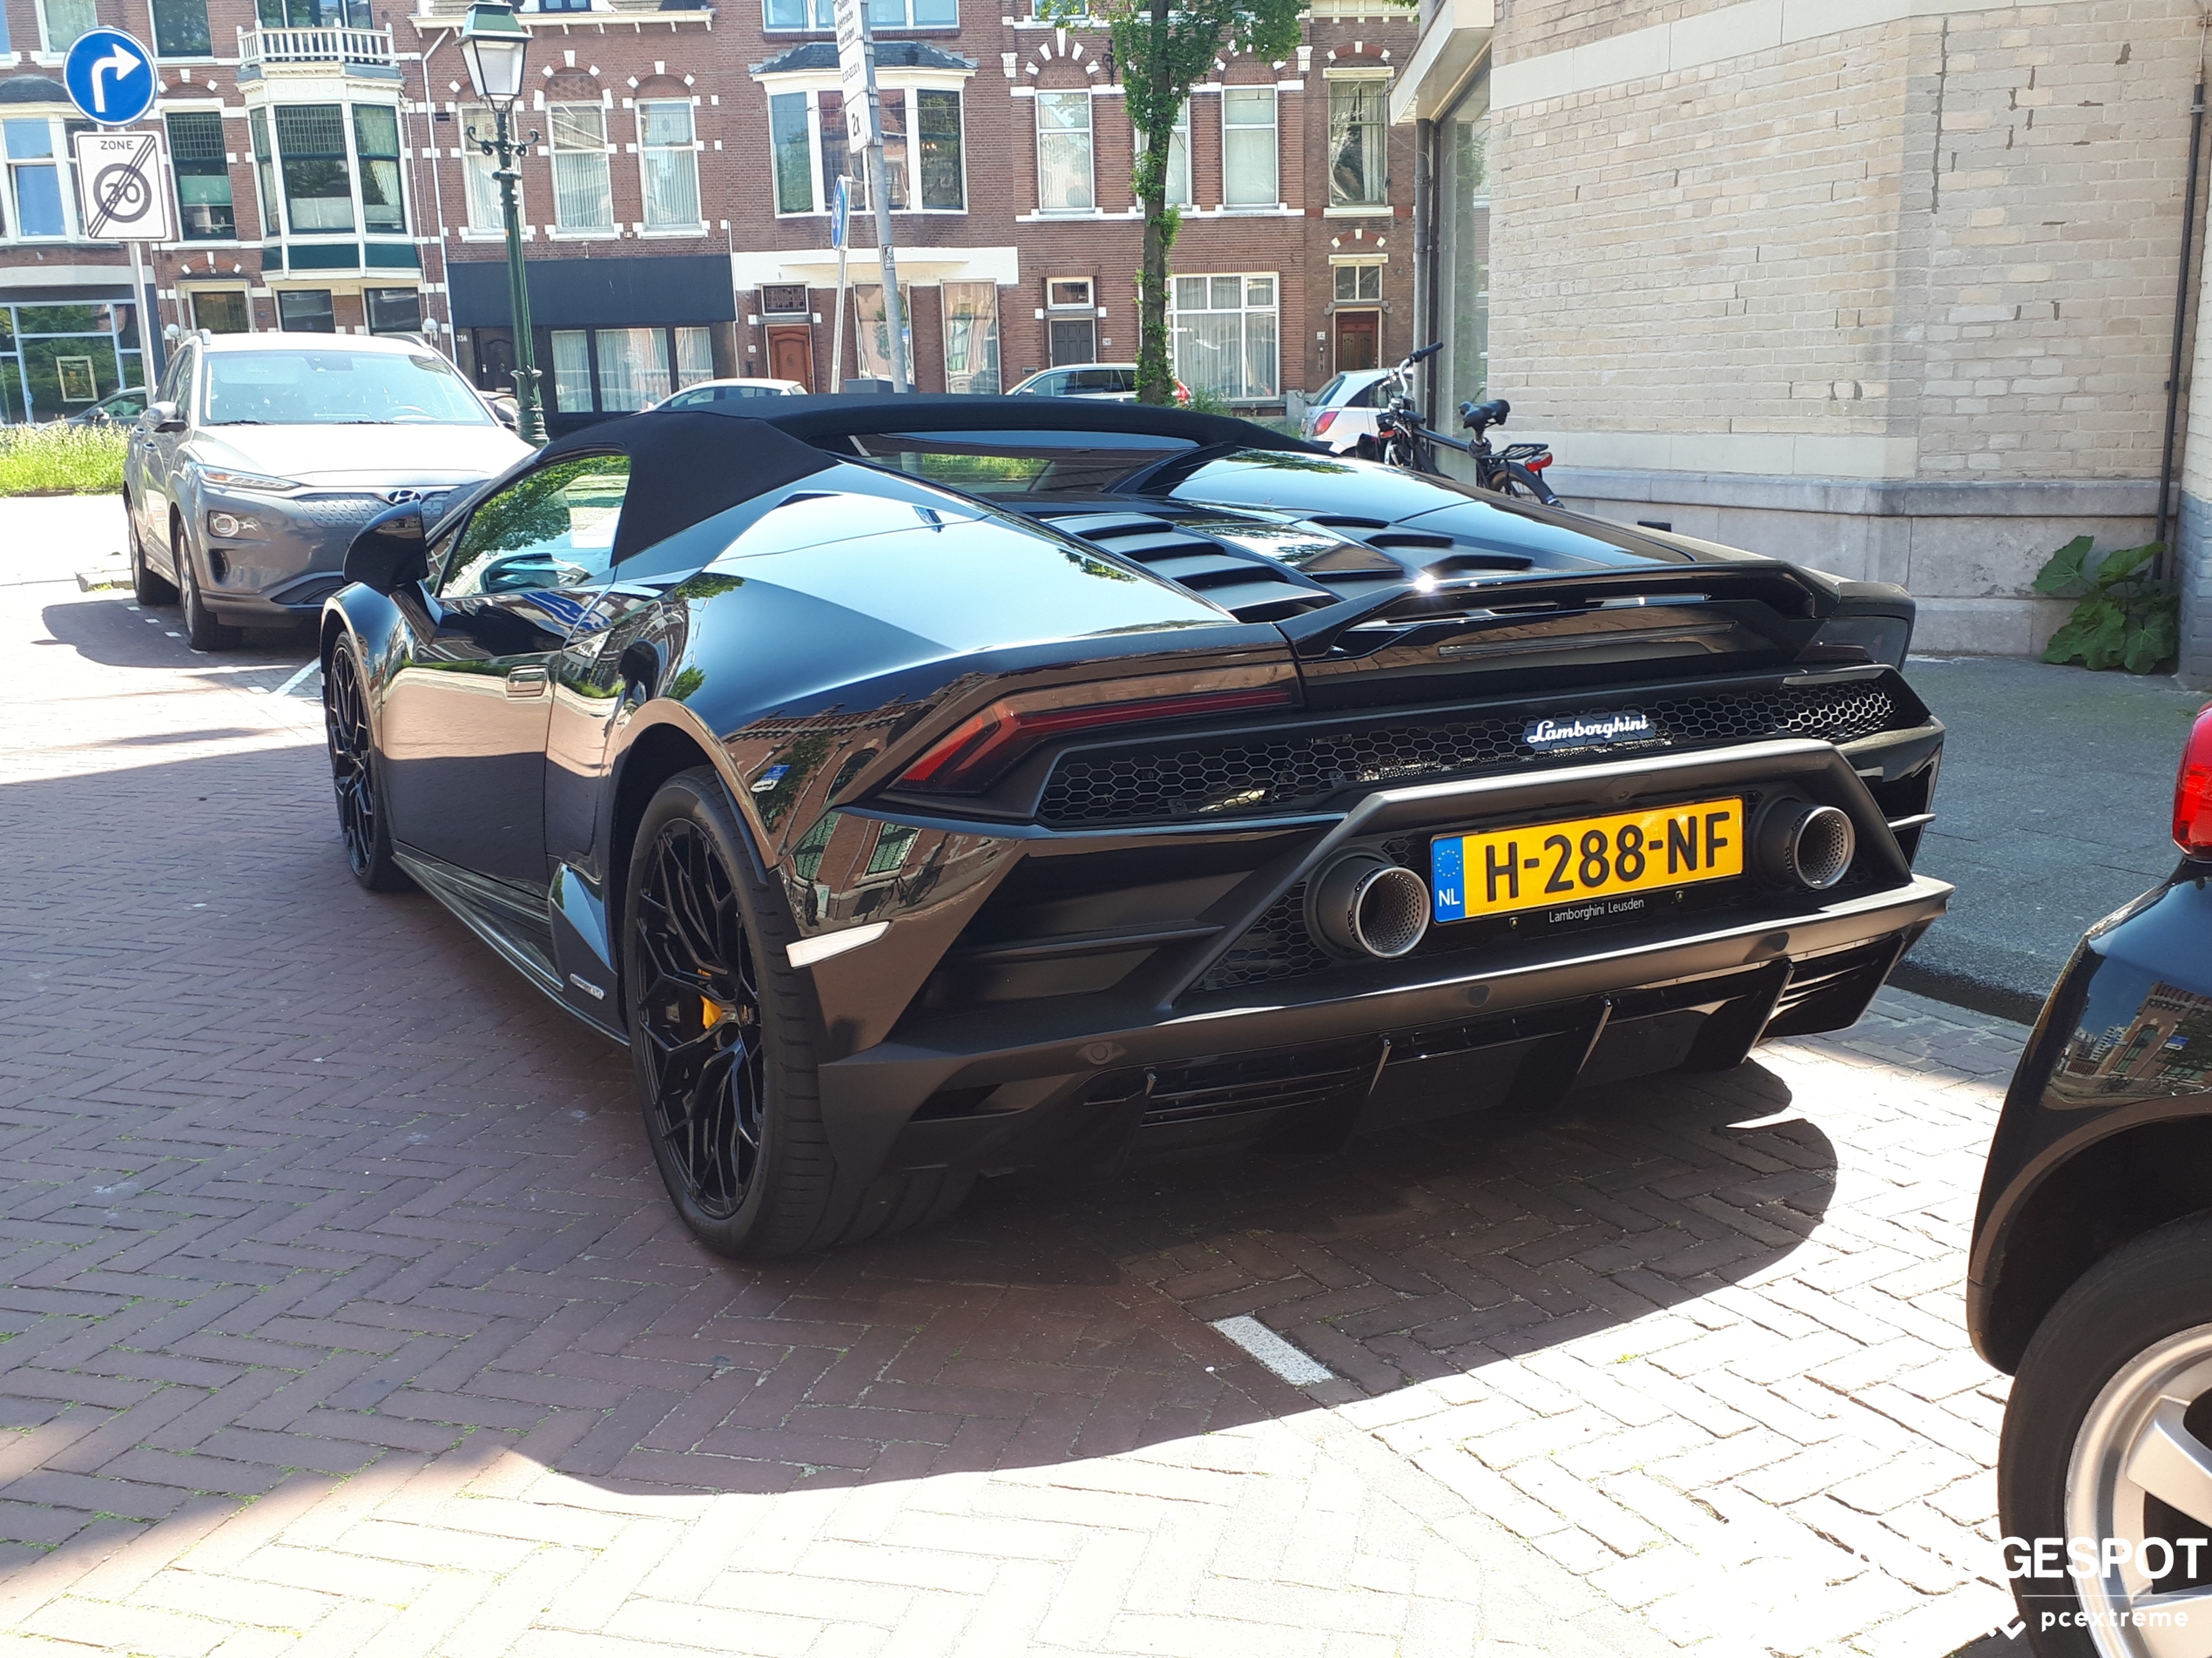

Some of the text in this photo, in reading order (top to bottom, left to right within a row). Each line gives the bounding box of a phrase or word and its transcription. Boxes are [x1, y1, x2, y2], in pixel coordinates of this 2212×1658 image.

[100, 140, 134, 150] ZONE
[1527, 714, 1649, 743] Lamborghini
[1485, 811, 1730, 903] H-288-NF
[1439, 888, 1460, 907] NL
[1549, 898, 1644, 923] Lamborghini Leusden
